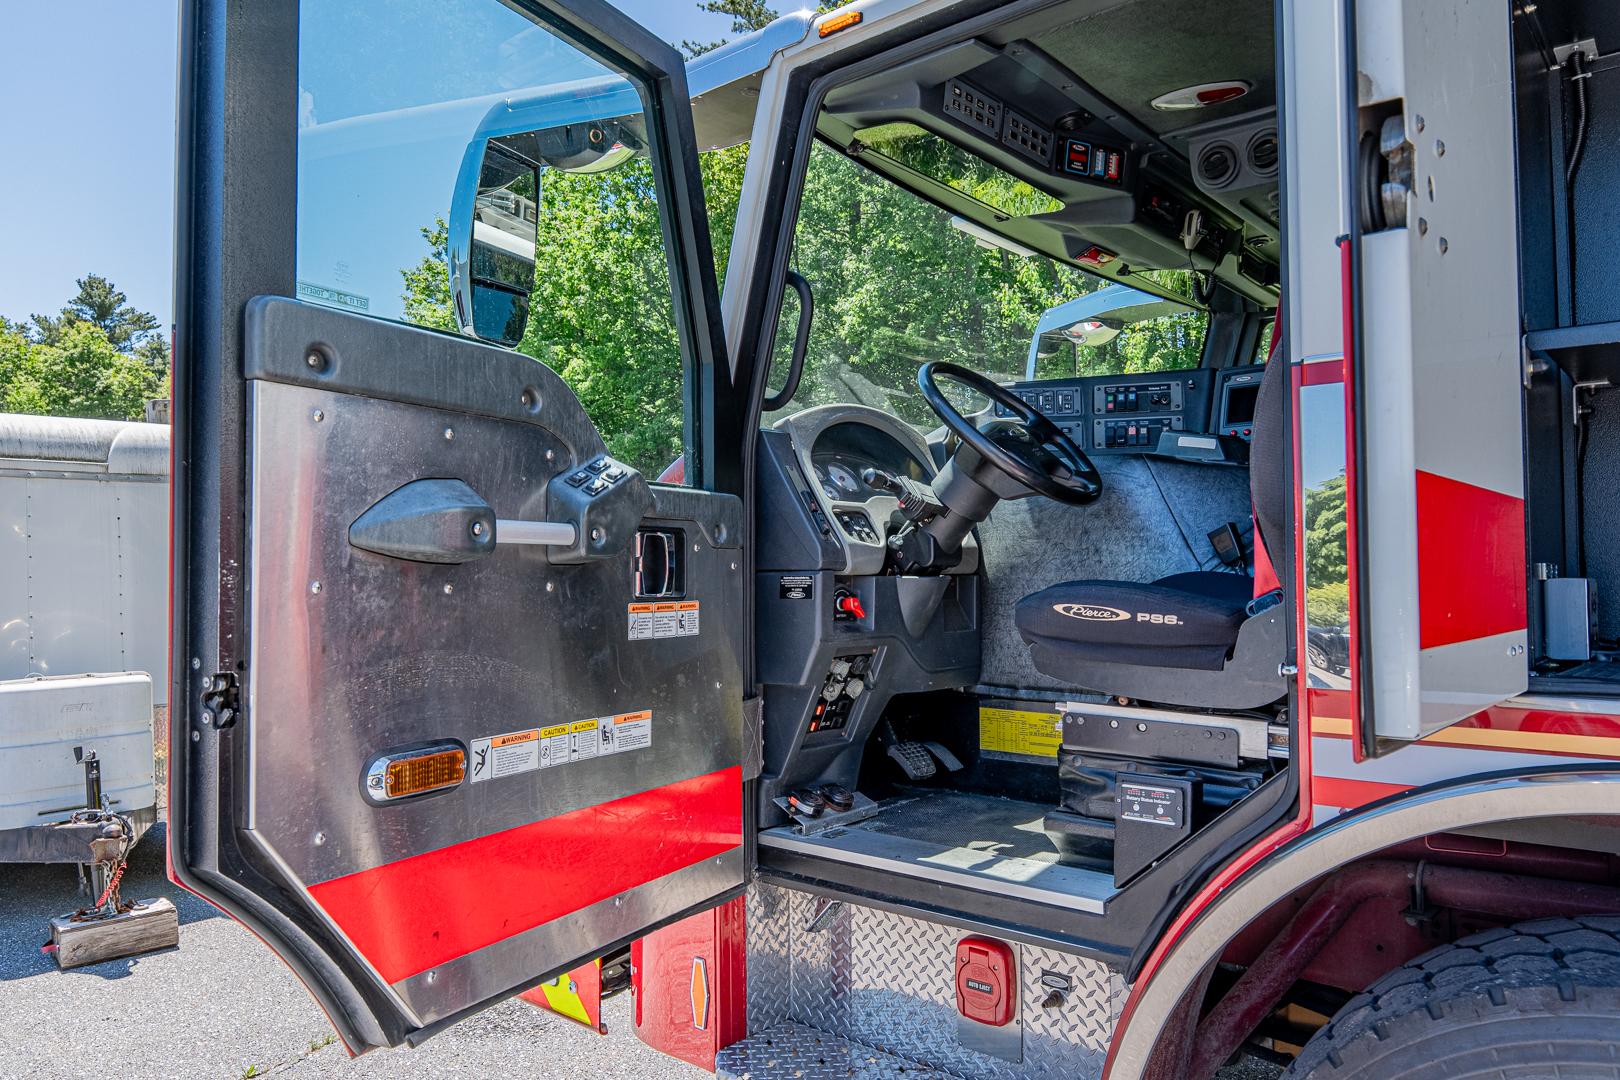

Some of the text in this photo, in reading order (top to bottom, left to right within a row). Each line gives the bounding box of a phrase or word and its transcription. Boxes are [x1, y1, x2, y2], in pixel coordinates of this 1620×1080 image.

[1070, 604, 1113, 619] Pierce
[543, 727, 566, 736] CAUTION
[506, 733, 531, 744] WARNING
